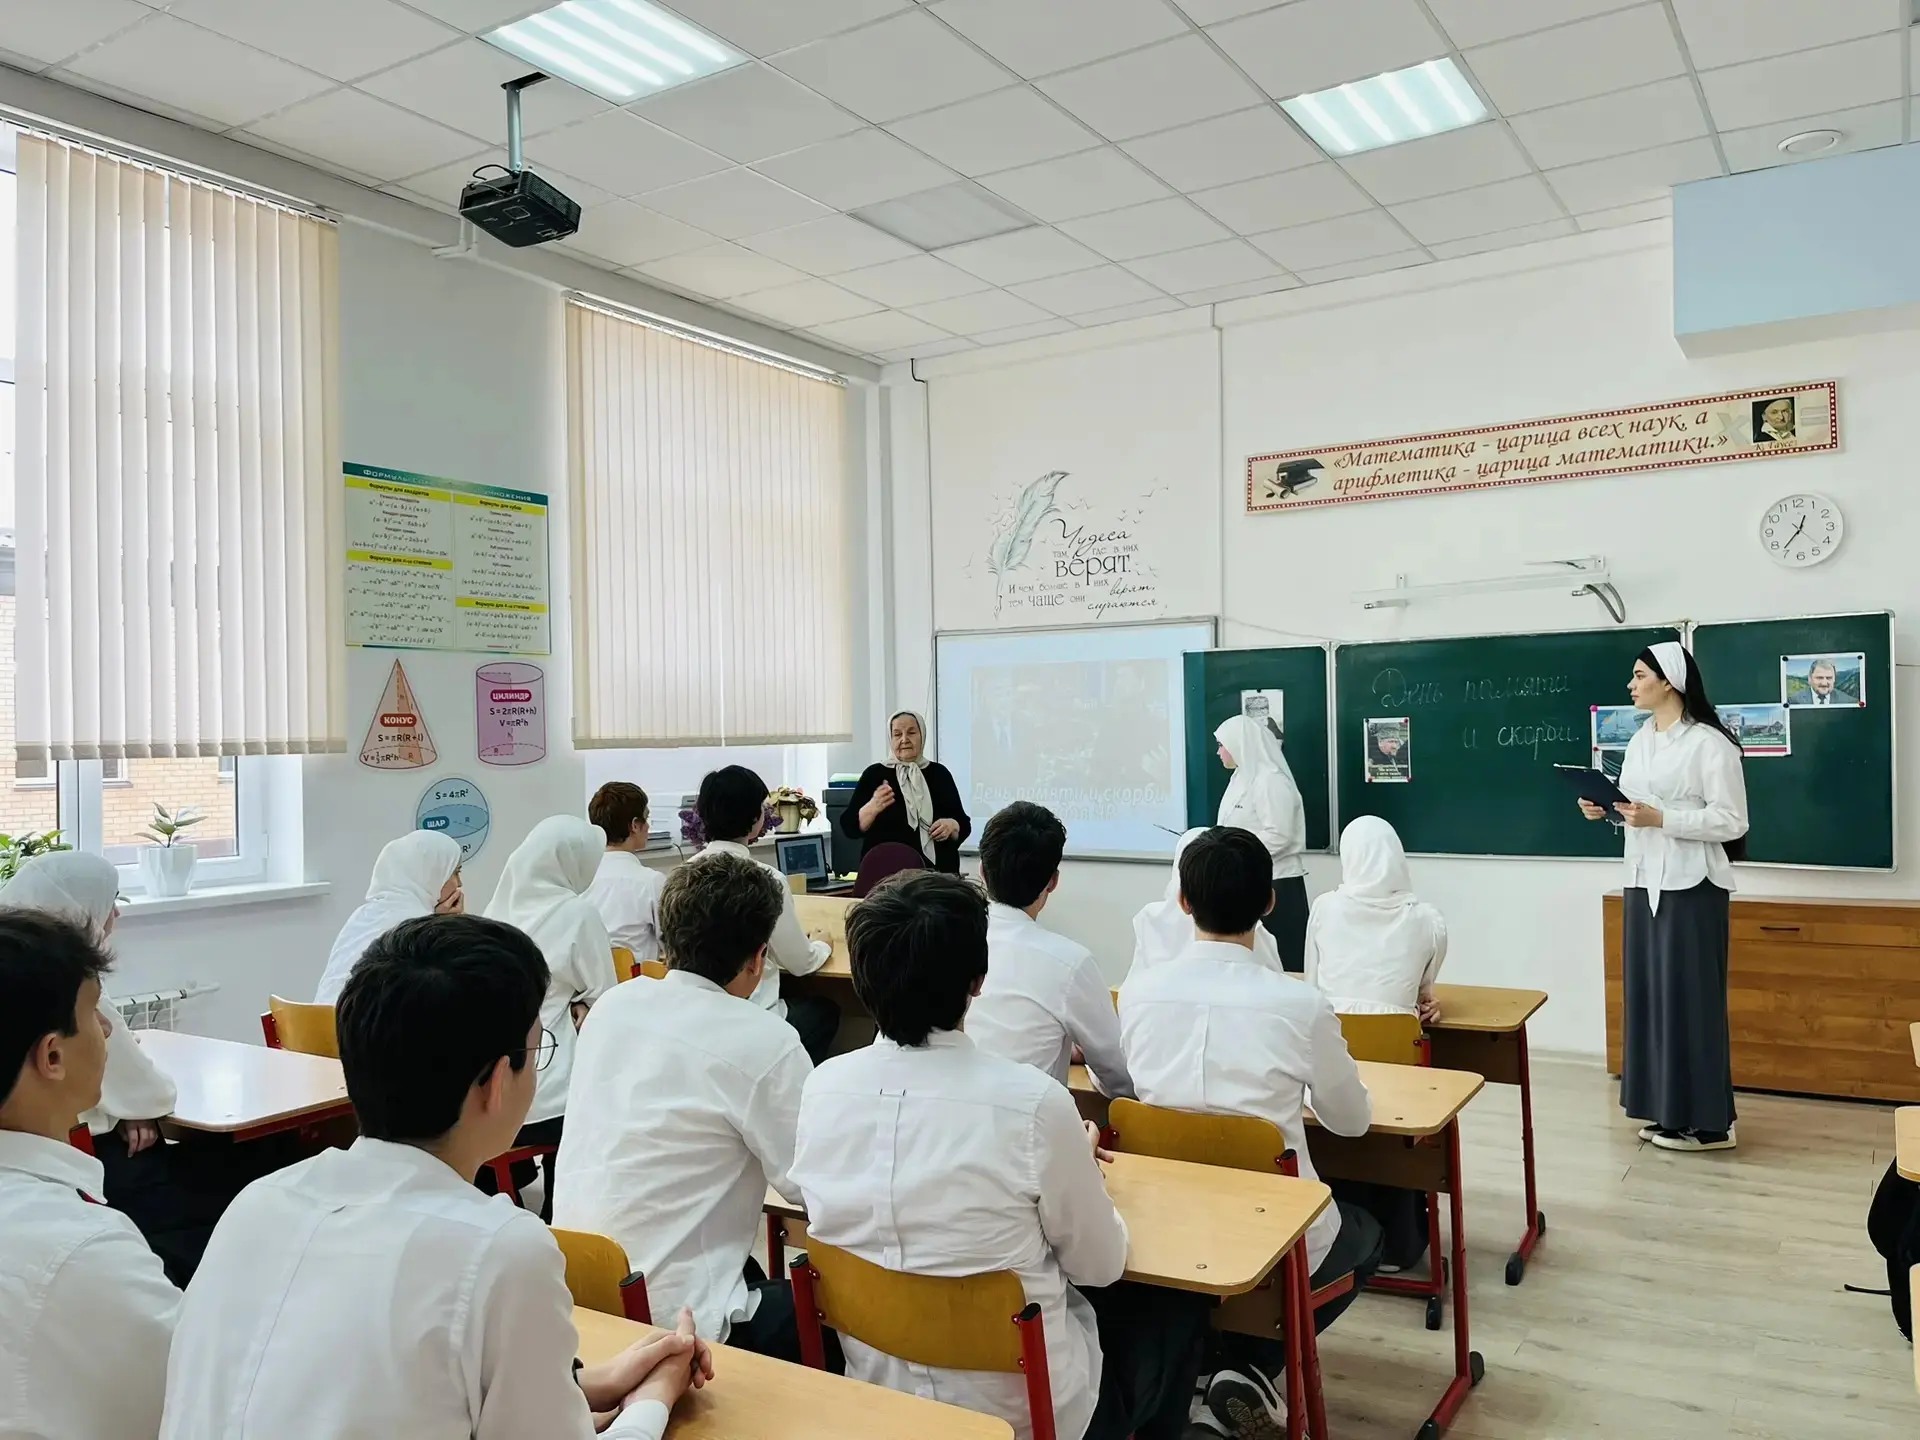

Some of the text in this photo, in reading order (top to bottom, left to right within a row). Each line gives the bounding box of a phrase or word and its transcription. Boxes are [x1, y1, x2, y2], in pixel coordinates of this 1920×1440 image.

[1334, 441, 1476, 469] «Математика
[1496, 429, 1570, 454] царица
[1578, 422, 1624, 440] всех
[1629, 414, 1687, 436] наук,
[1695, 411, 1708, 425] а
[1333, 466, 1457, 495] арифметика
[1477, 455, 1550, 478] царица
[1556, 434, 1728, 466] математики.»
[1780, 503, 1787, 512] 11
[1792, 498, 1804, 508] 12
[1812, 500, 1815, 509] 1
[1821, 508, 1830, 519] 2
[1768, 514, 1780, 524] 10
[1826, 521, 1835, 531] 3
[1765, 528, 1774, 538] 9
[1050, 518, 1132, 559] Чудеса
[1822, 535, 1831, 545] 4
[1123, 544, 1139, 552] них
[1771, 541, 1779, 550] 8
[1783, 549, 1790, 559] 7
[1796, 552, 1805, 560] 6
[1812, 547, 1821, 556] 5
[1056, 554, 1131, 585] верят.
[1009, 584, 1016, 594] И
[1093, 579, 1109, 588] них
[1028, 593, 1064, 607] чаще
[1069, 595, 1085, 603] они
[1372, 668, 1571, 707] День памяти
[1463, 727, 1479, 749] и
[974, 782, 1011, 803] День
[1088, 787, 1100, 803] и
[427, 819, 446, 828] ШАР
